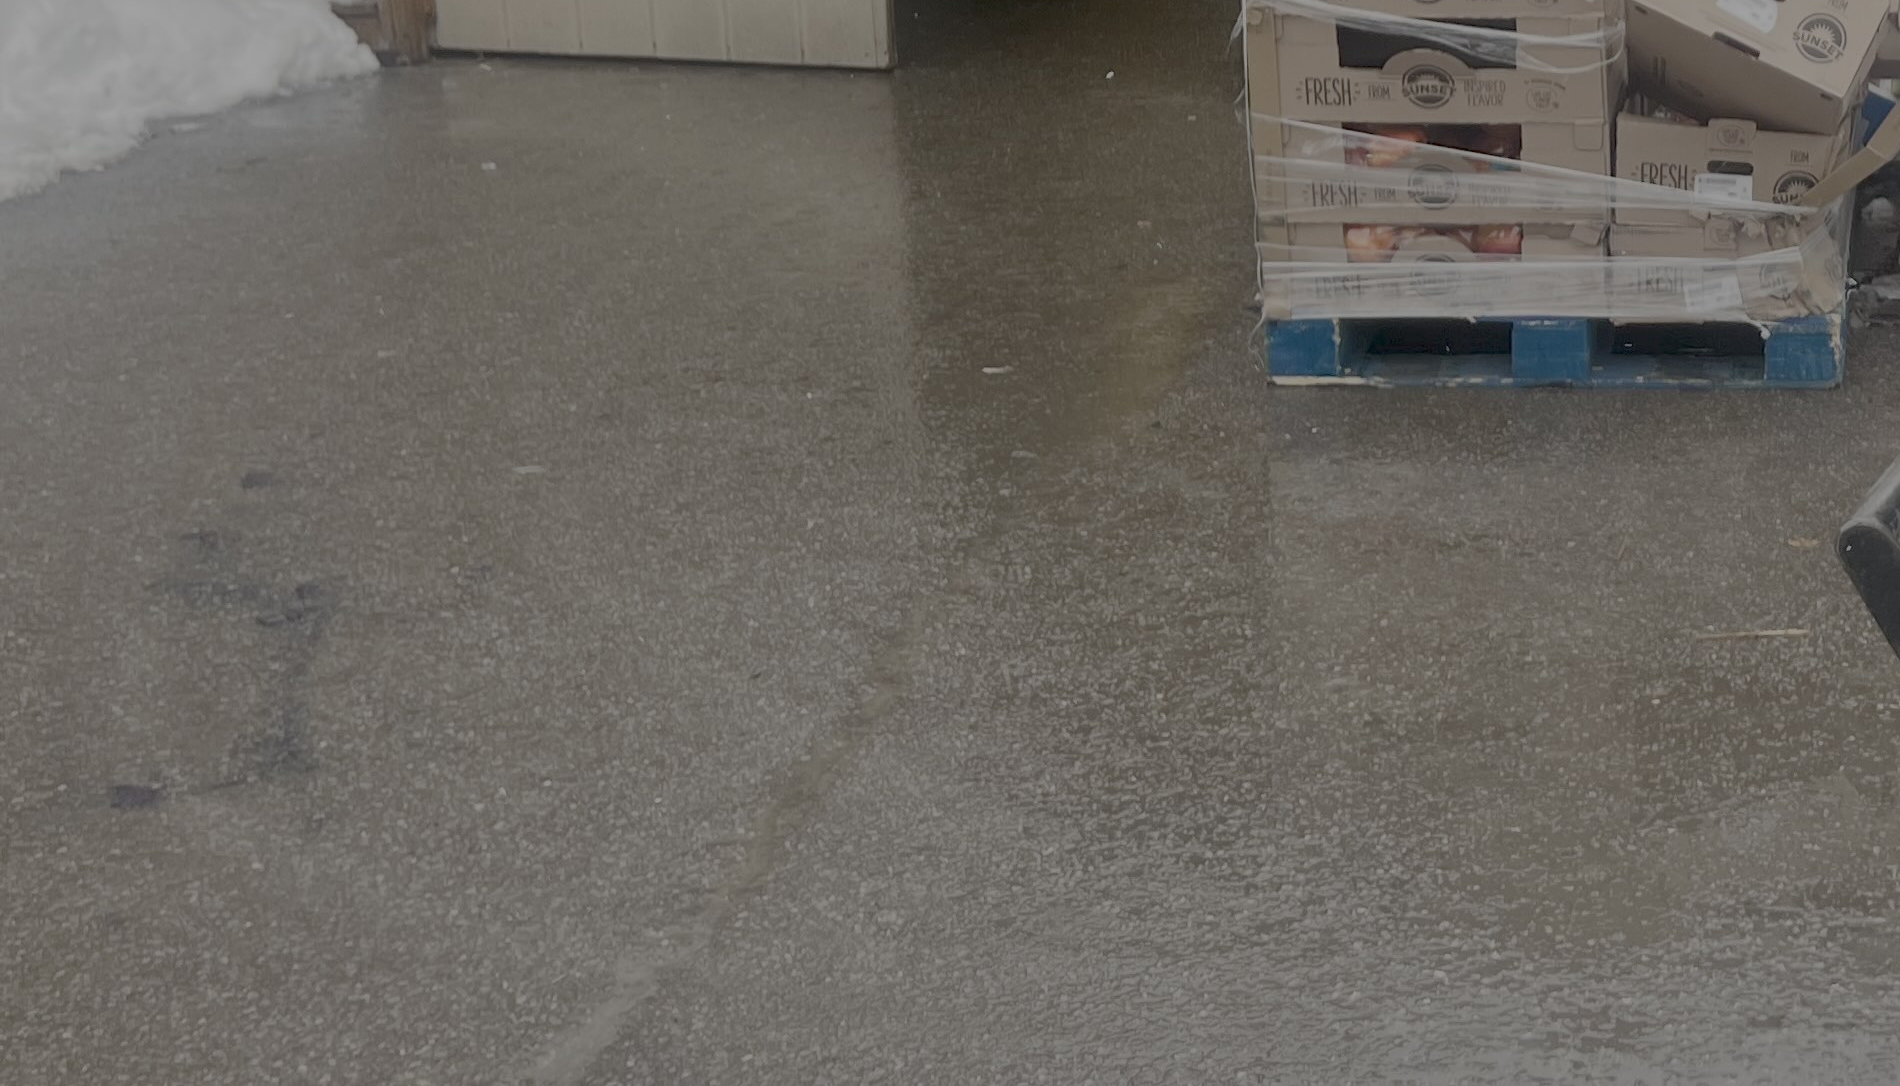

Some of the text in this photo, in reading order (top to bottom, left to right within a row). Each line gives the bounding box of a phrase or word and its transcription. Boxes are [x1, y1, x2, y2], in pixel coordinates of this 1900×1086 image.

[1792, 30, 1844, 61] SUNSET
[1304, 77, 1506, 107] FRESH FROM SUNSET INSPIRED
[1467, 93, 1504, 107] FLAVOR
[1790, 150, 1809, 164] FROM
[1640, 162, 1688, 191] FRESH
[1311, 178, 1359, 208] FRESH
